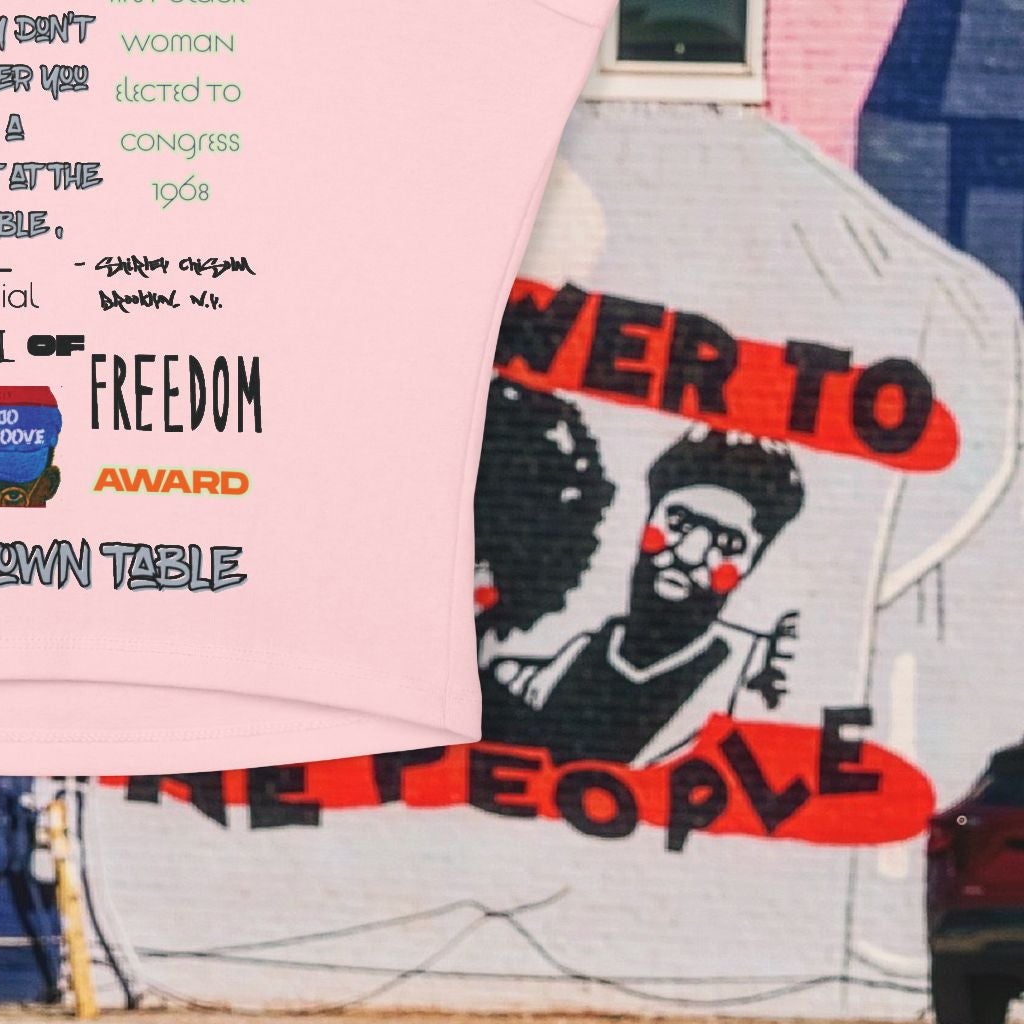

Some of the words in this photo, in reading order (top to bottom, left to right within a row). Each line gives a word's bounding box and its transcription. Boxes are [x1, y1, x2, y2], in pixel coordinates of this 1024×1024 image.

[14, 11, 97, 45] DON'T
[39, 63, 89, 101] YOU
[5, 113, 25, 142] A
[8, 162, 46, 191] AT
[46, 162, 104, 191] THE
[152, 175, 209, 209] 1968
[27, 335, 85, 357] OF
[91, 353, 263, 433] FREEDOM
[785, 340, 934, 455] TO
[94, 468, 249, 495] AWARD
[99, 542, 248, 594] TABLE
